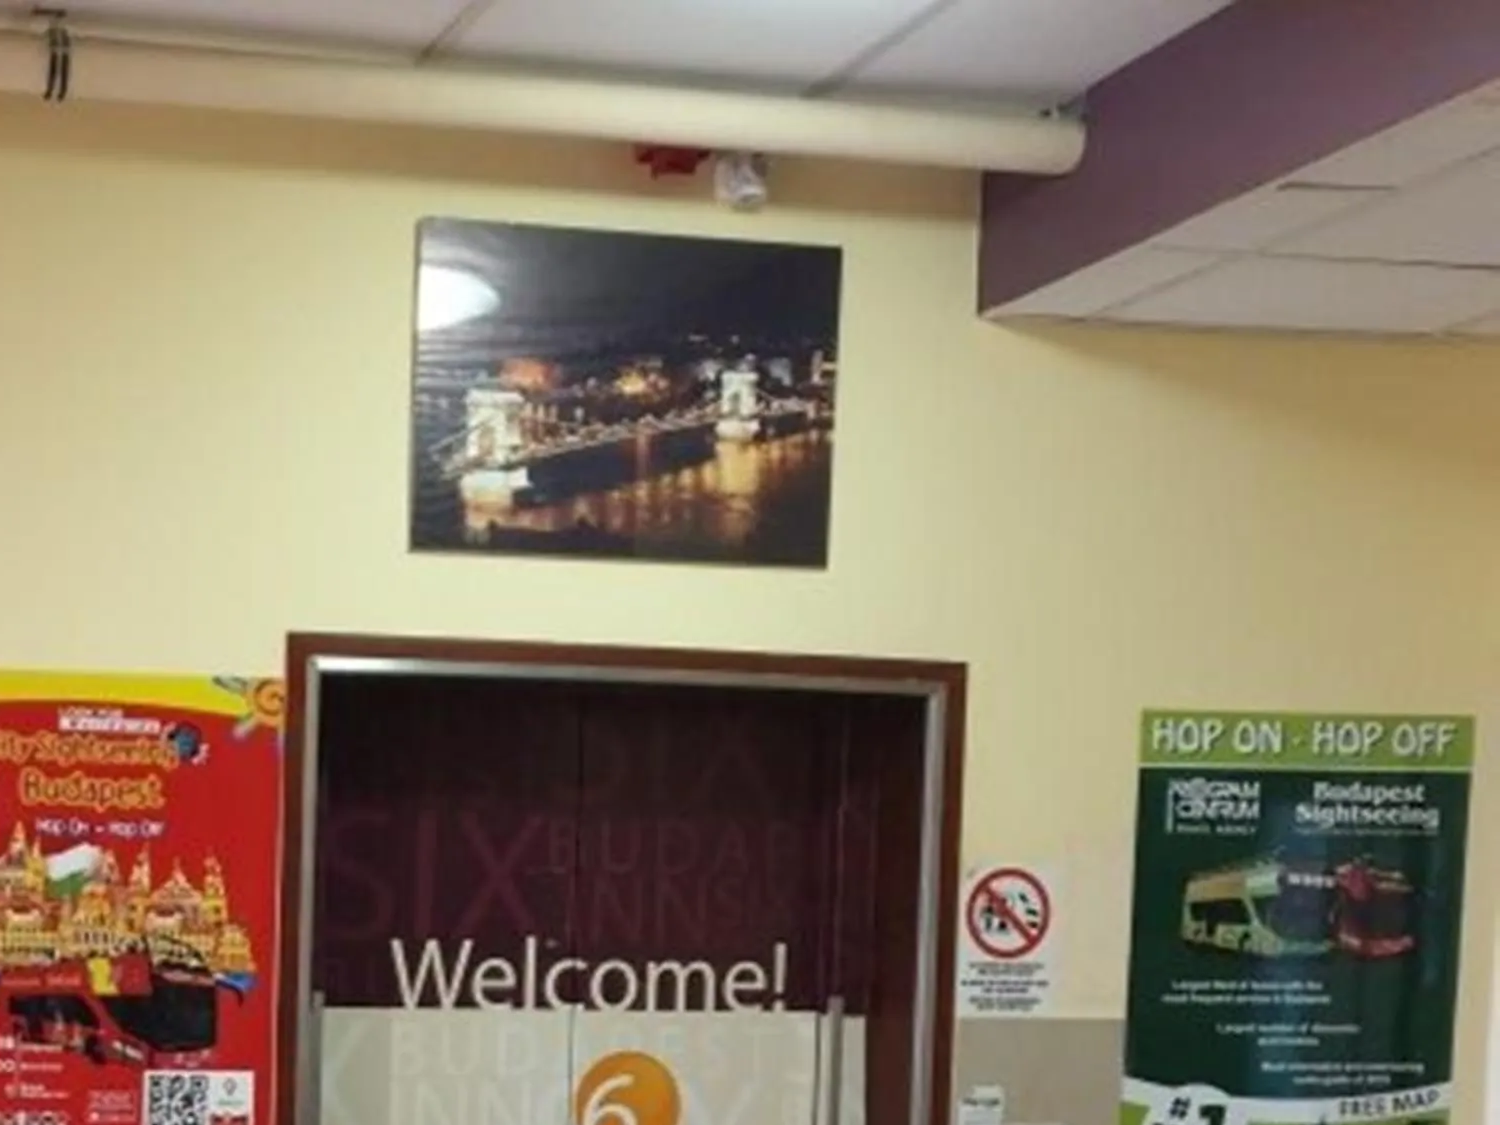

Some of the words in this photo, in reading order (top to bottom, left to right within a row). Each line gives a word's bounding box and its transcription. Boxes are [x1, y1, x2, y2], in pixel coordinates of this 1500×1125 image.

[1152, 719, 1223, 751] HOP
[1233, 720, 1283, 752] ON
[1312, 722, 1383, 755] HOP
[1391, 723, 1457, 757] OFF
[19, 767, 165, 813] Budapest
[1313, 781, 1426, 804] Budapest
[1295, 803, 1439, 829] Sightseeing
[390, 936, 788, 1012] Welcome!
[1392, 1089, 1440, 1111] MAP
